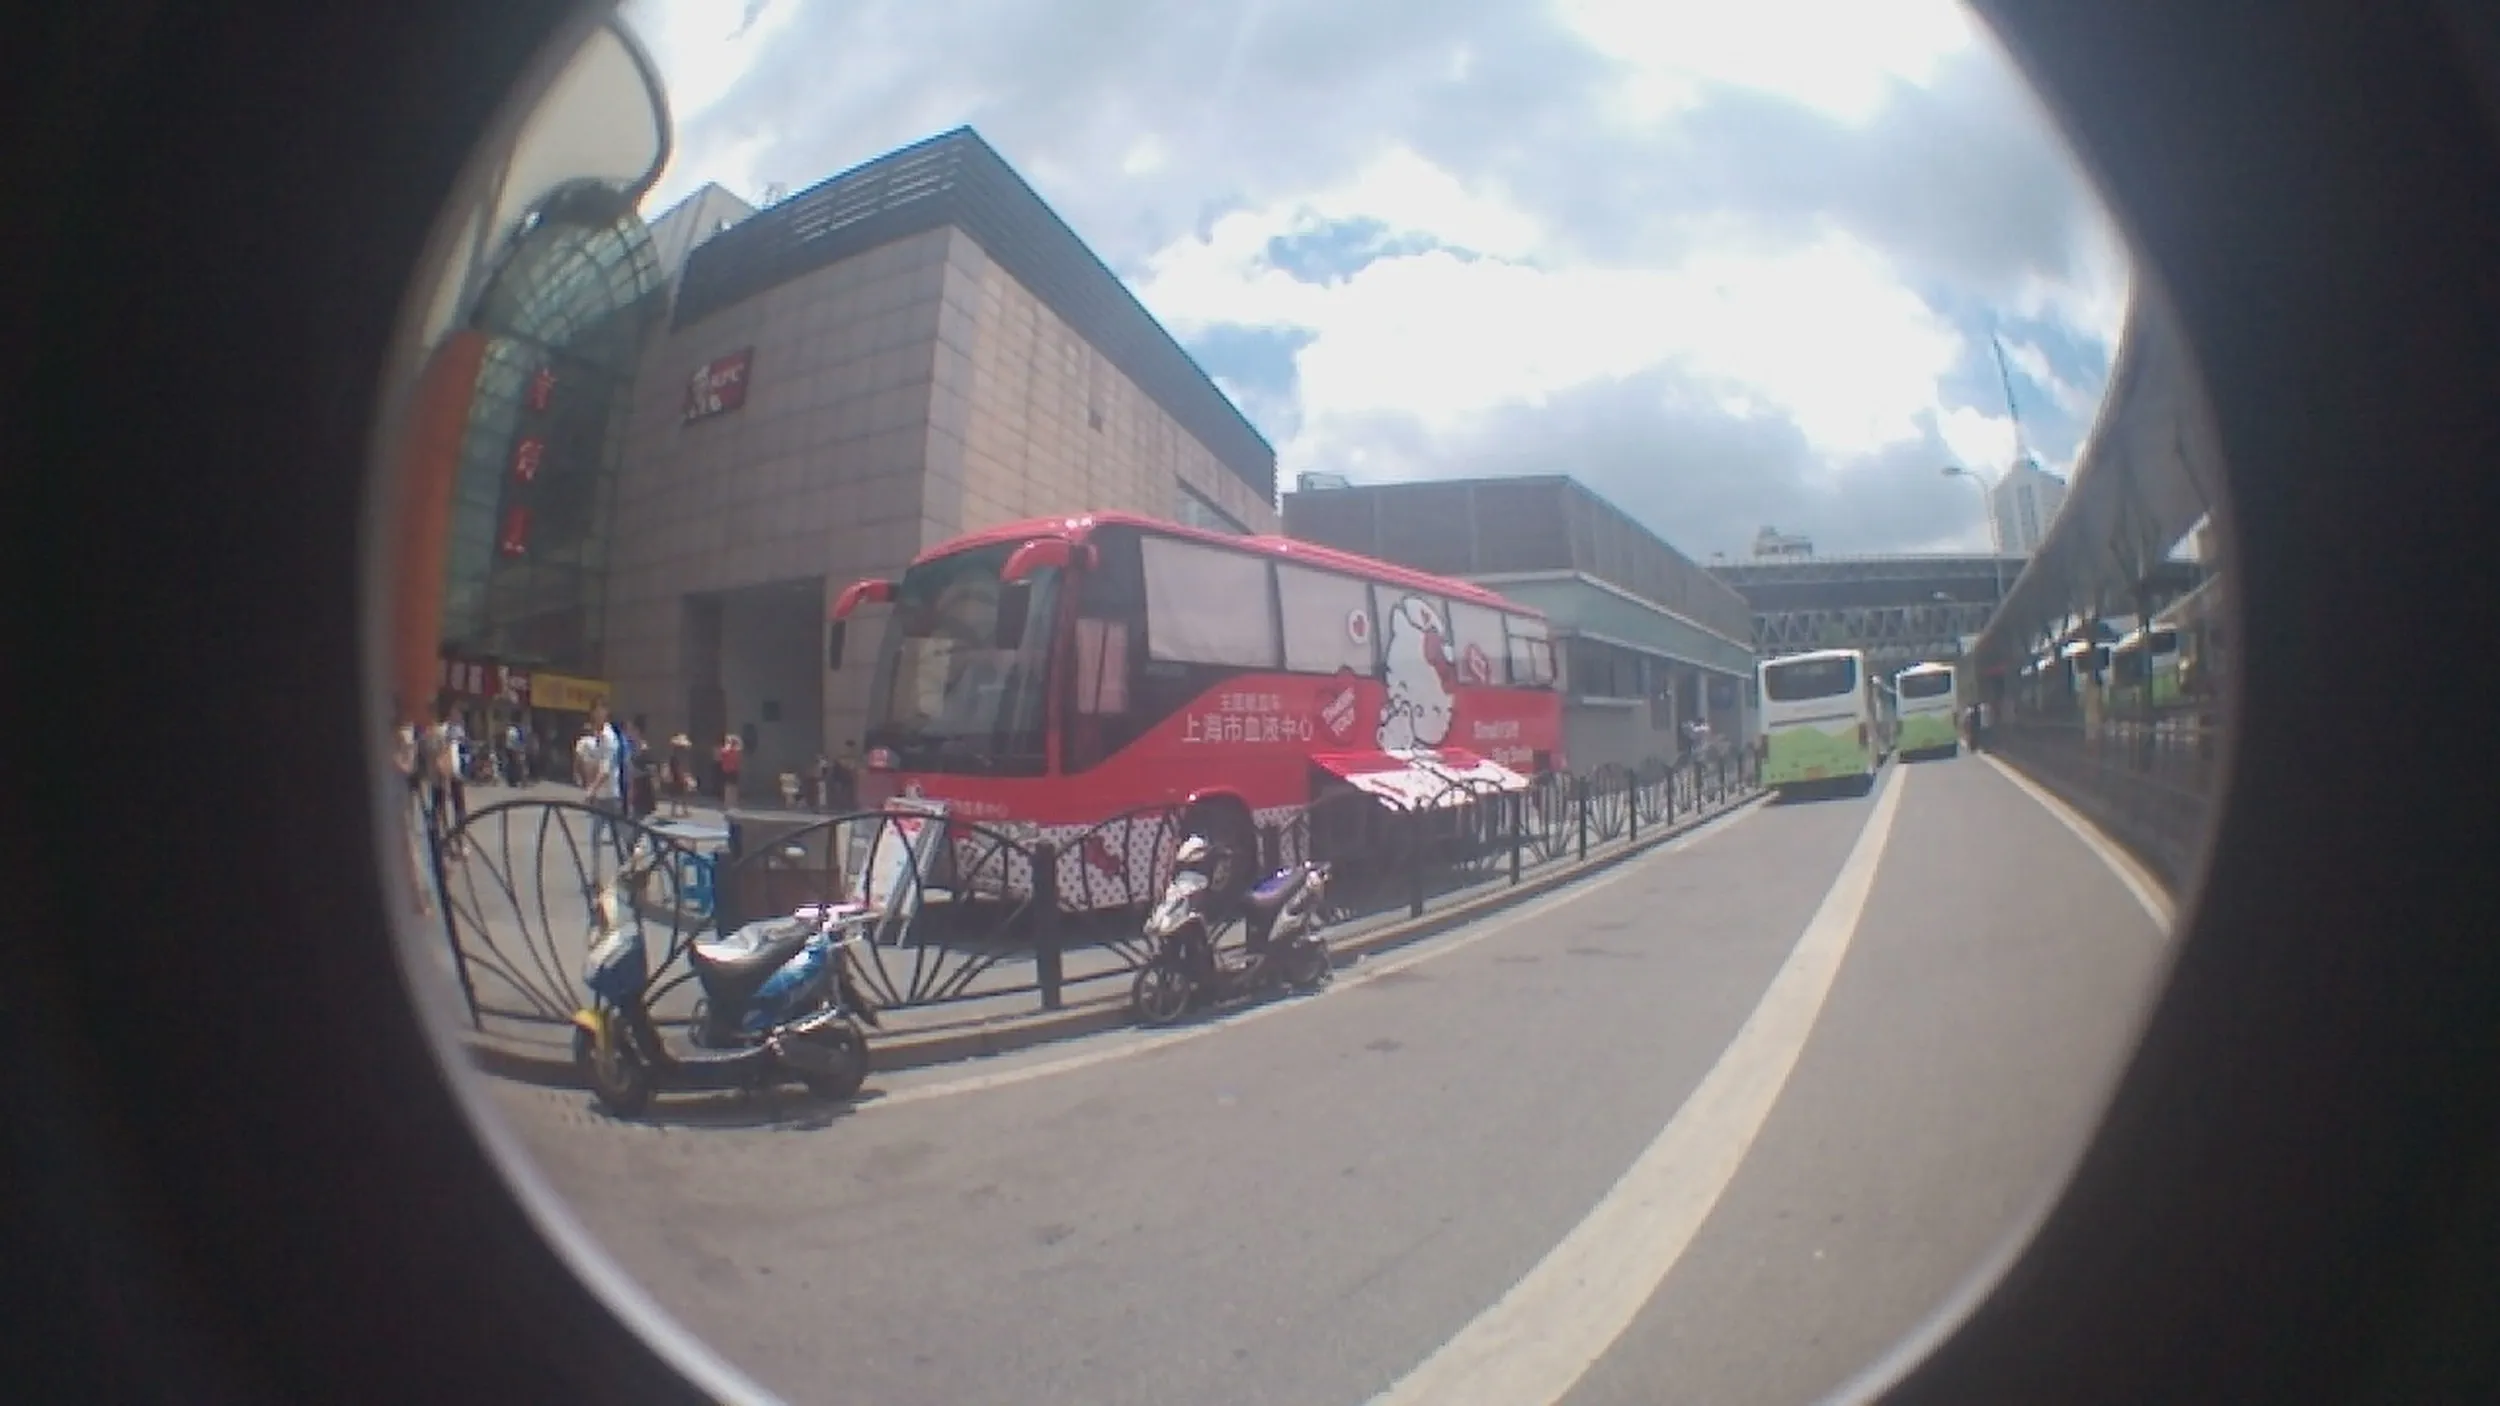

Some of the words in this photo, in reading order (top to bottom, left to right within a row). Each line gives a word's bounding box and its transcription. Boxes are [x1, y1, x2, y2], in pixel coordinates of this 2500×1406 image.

[1182, 713, 1313, 742] 上海市血液中心
